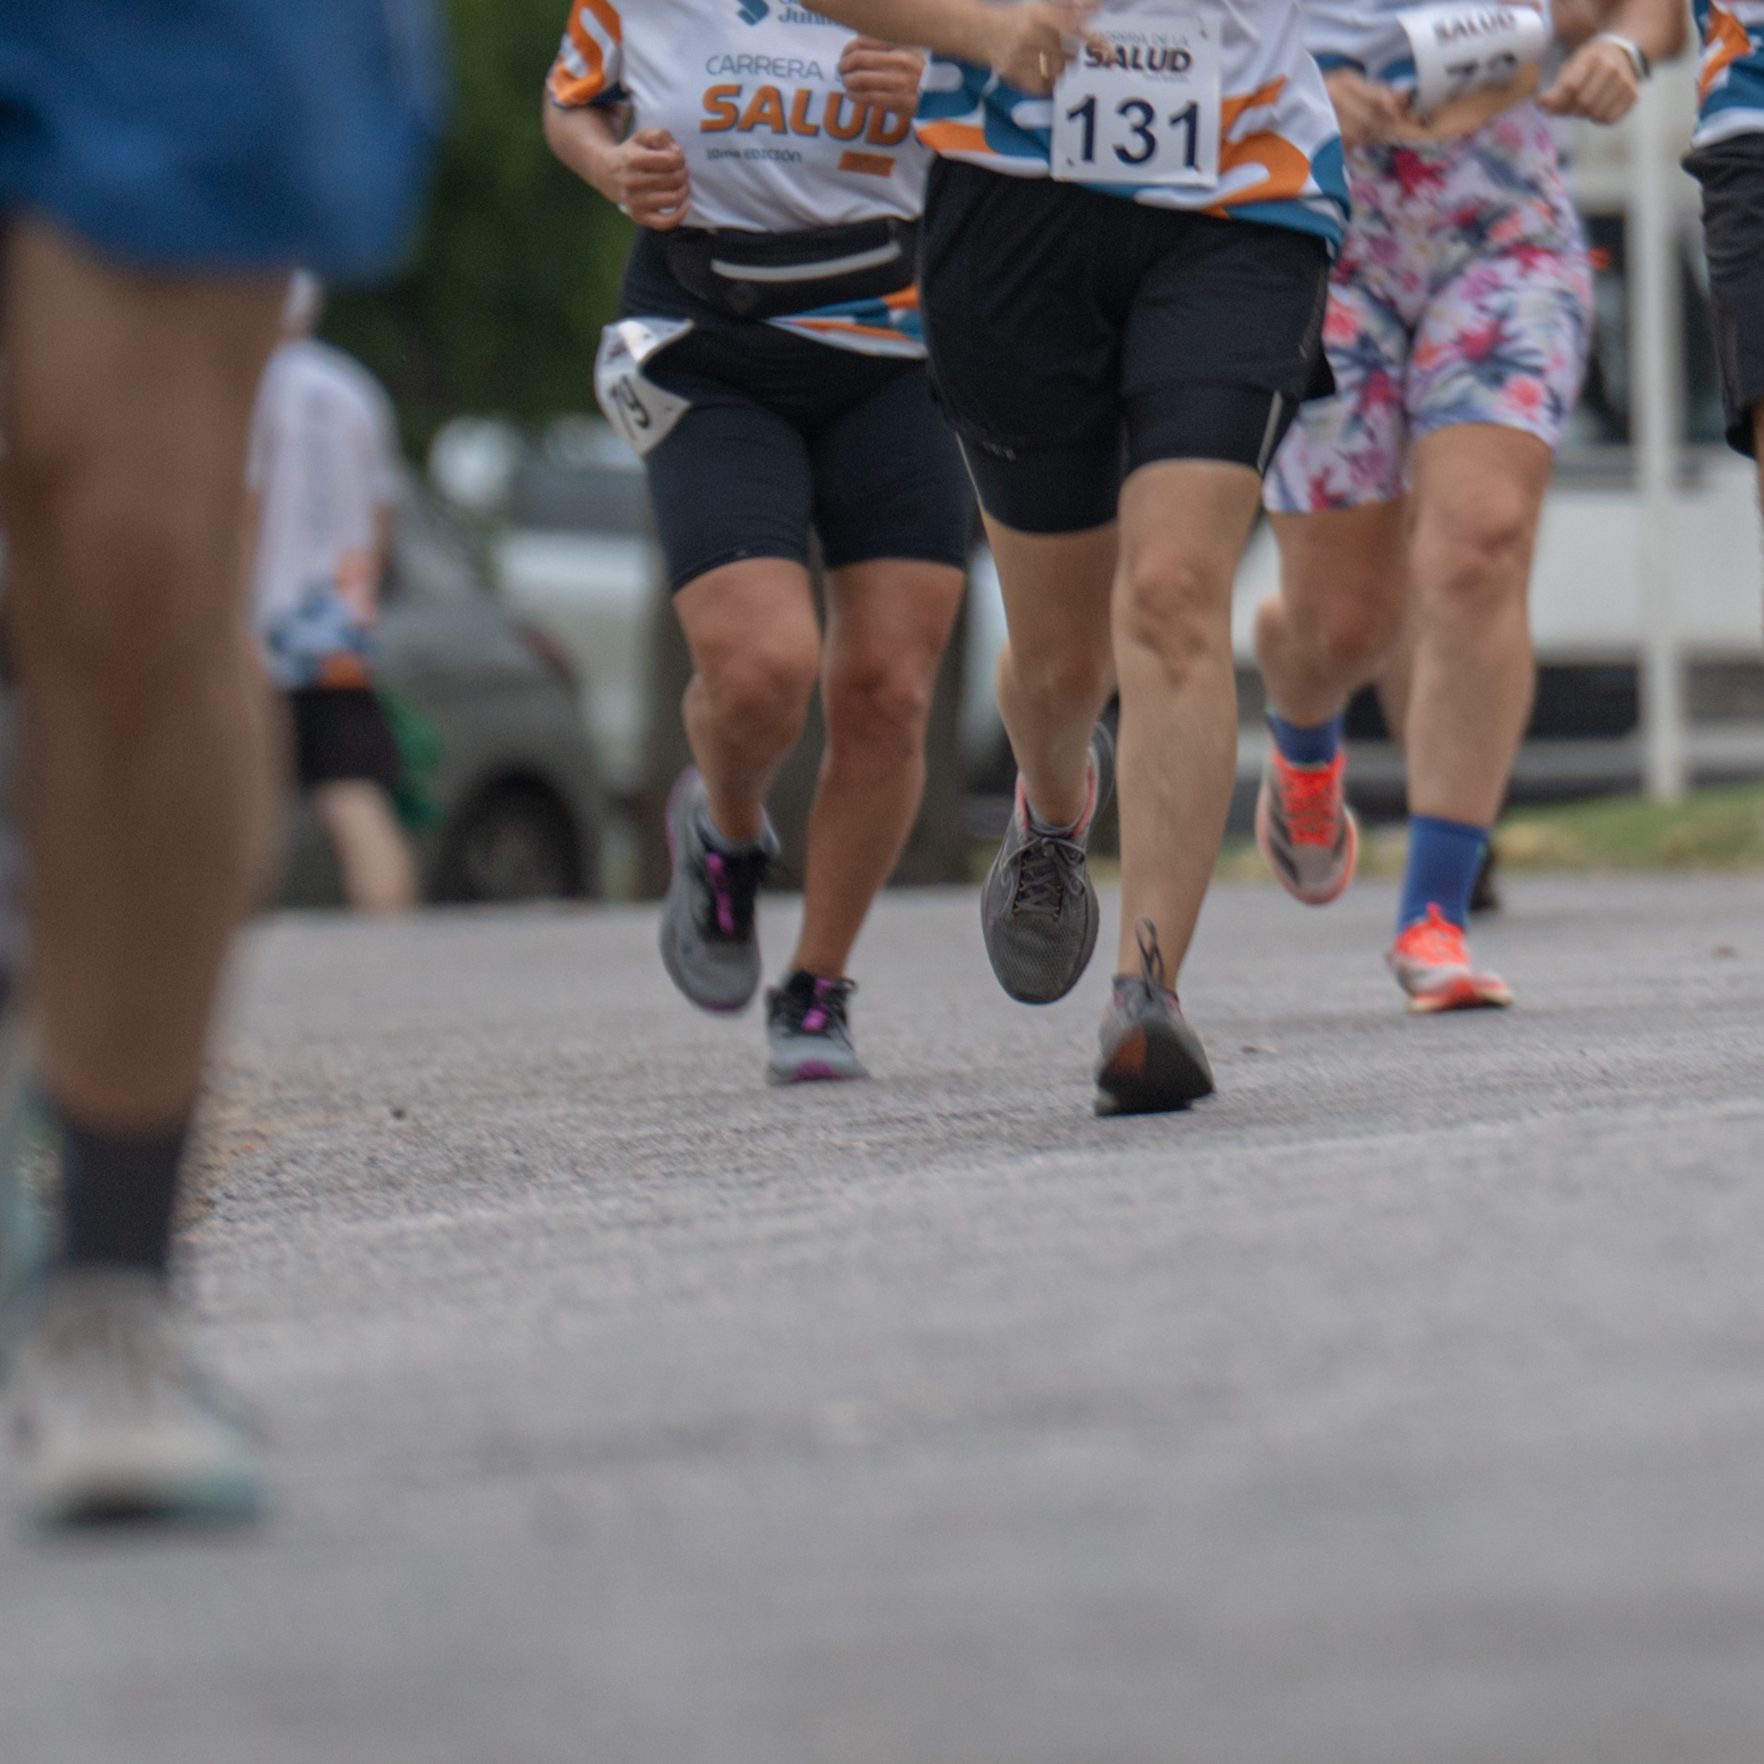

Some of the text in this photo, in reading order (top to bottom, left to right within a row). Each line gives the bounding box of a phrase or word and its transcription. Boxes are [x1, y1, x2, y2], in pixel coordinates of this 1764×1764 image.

[705, 53, 824, 81] CARRERA
[699, 83, 912, 146] SALUD
[1066, 93, 1199, 169] 131
